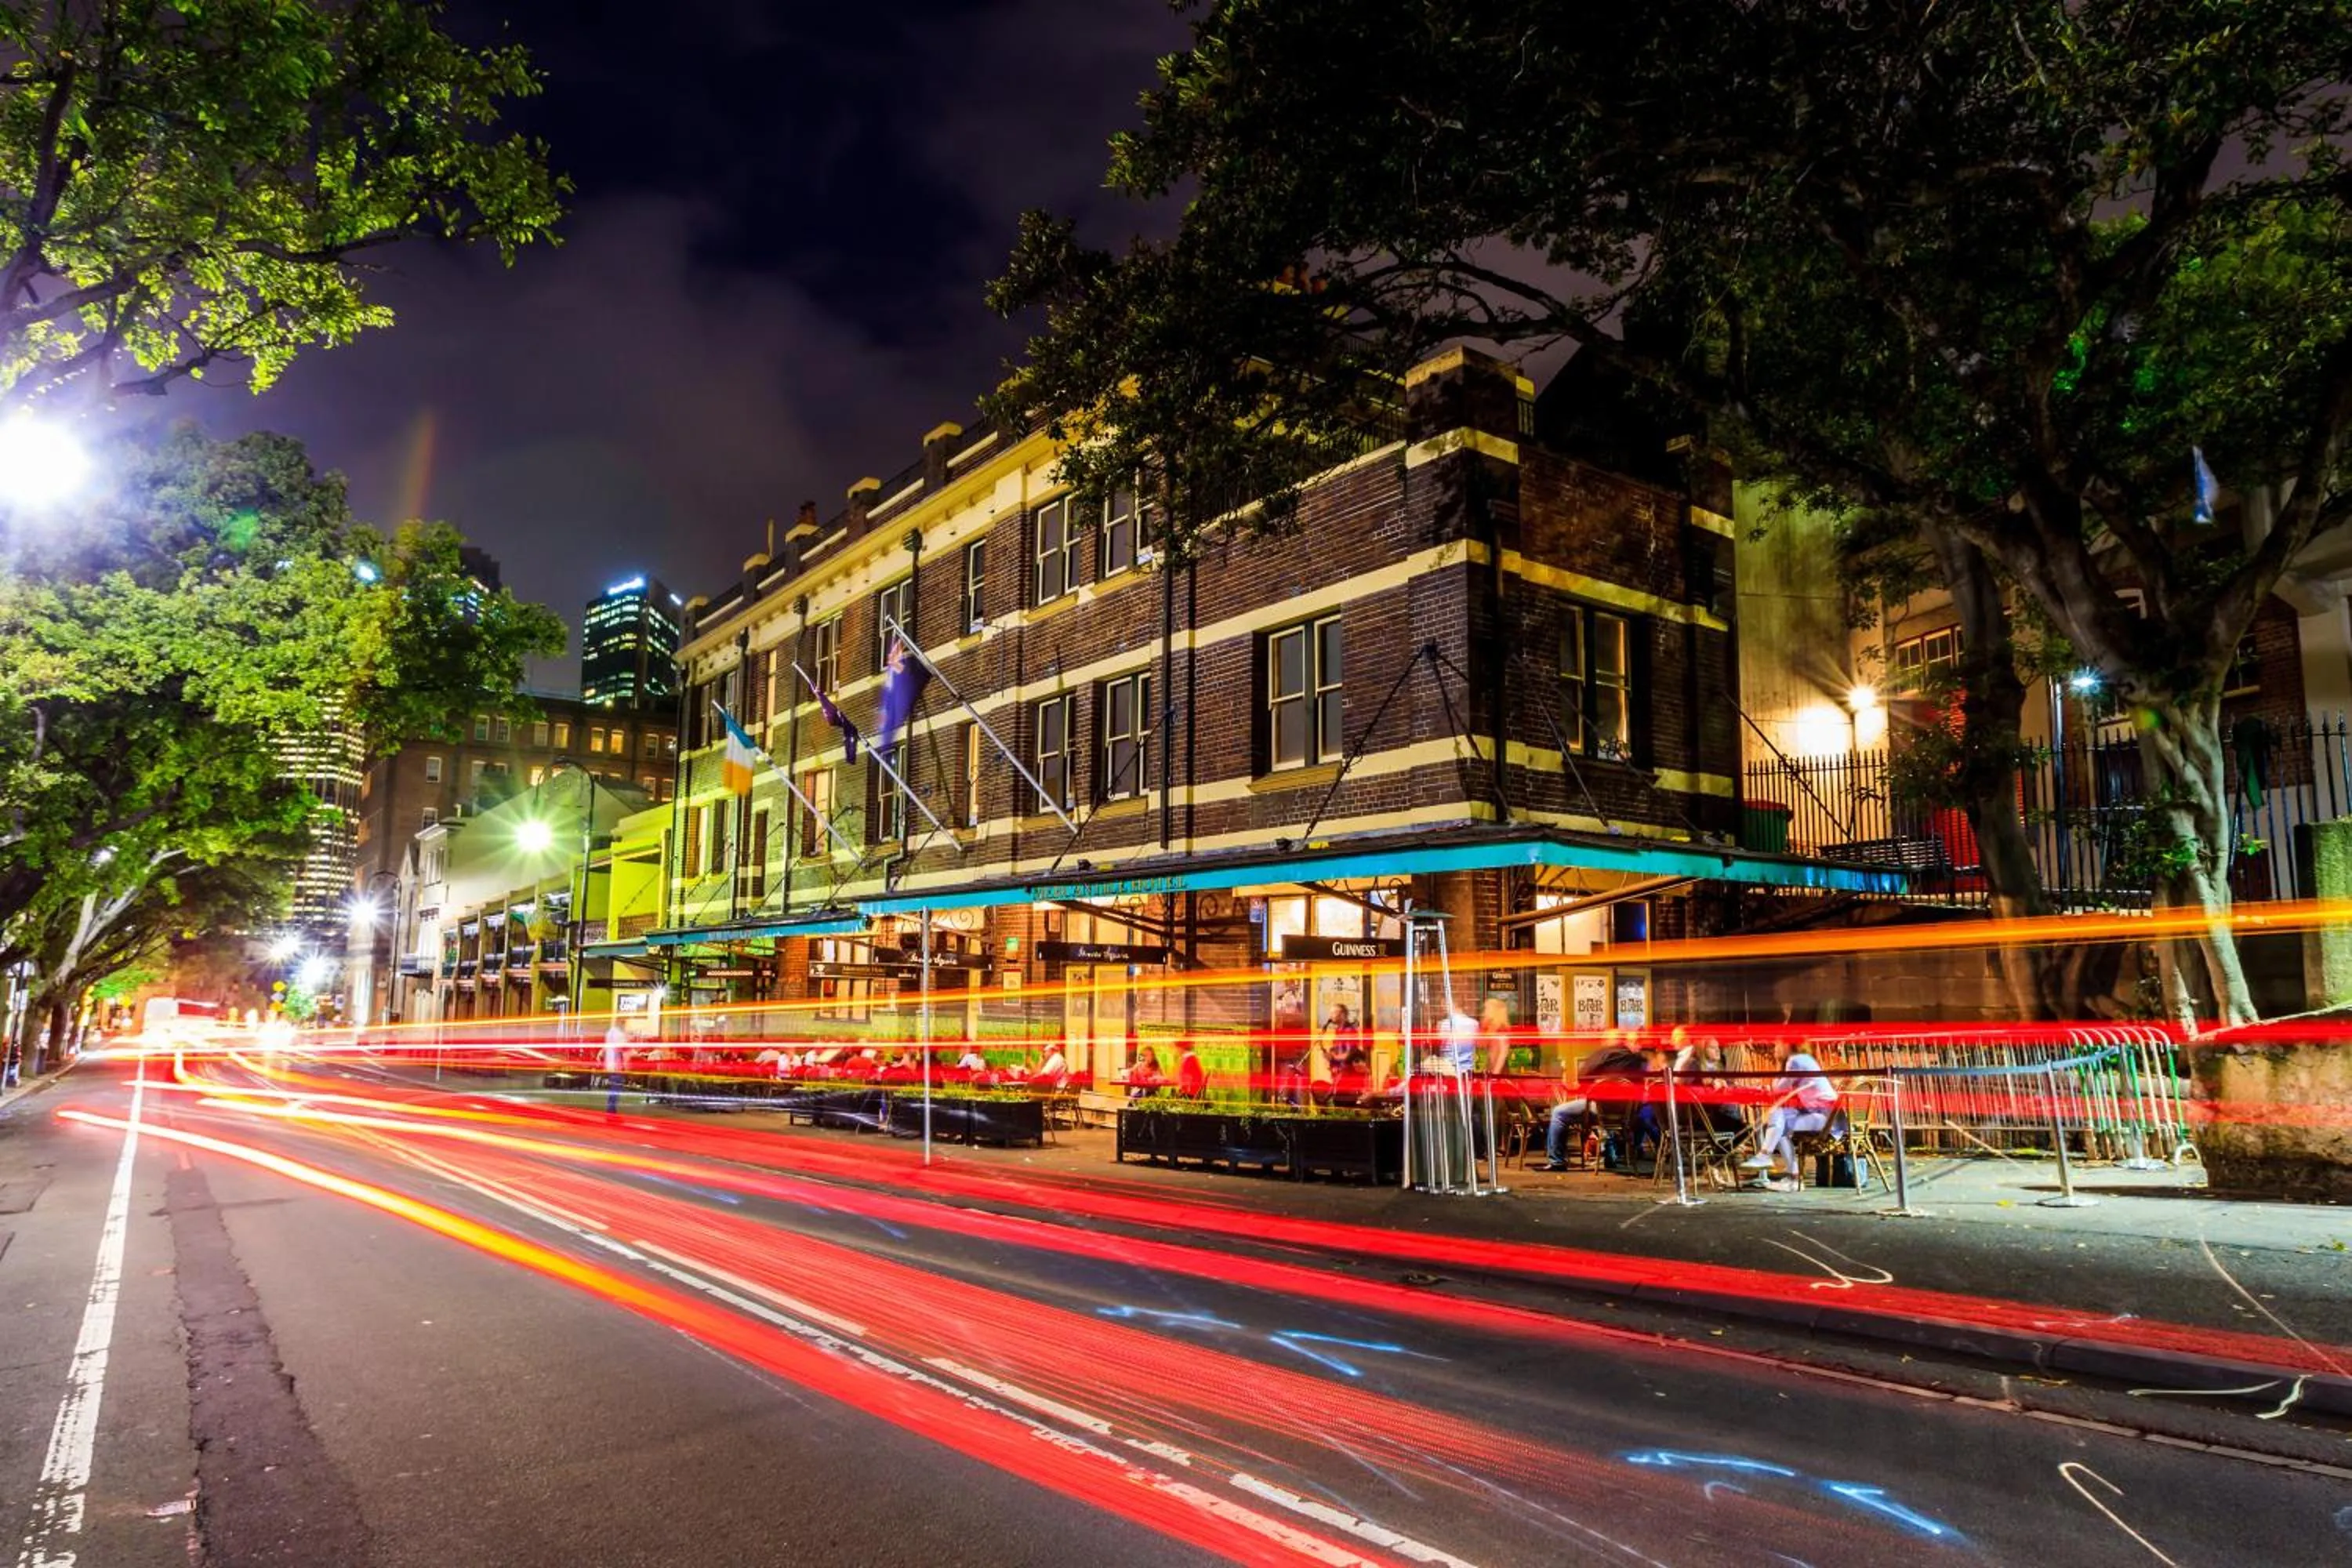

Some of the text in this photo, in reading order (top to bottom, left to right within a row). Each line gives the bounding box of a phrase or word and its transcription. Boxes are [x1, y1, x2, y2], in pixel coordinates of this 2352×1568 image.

[1131, 876, 1188, 892] HOTEL
[1332, 942, 1377, 956] GUINNESS
[1537, 997, 1559, 1012] AR
[1577, 998, 1603, 1012] BAR
[1620, 998, 1643, 1012] BAR
